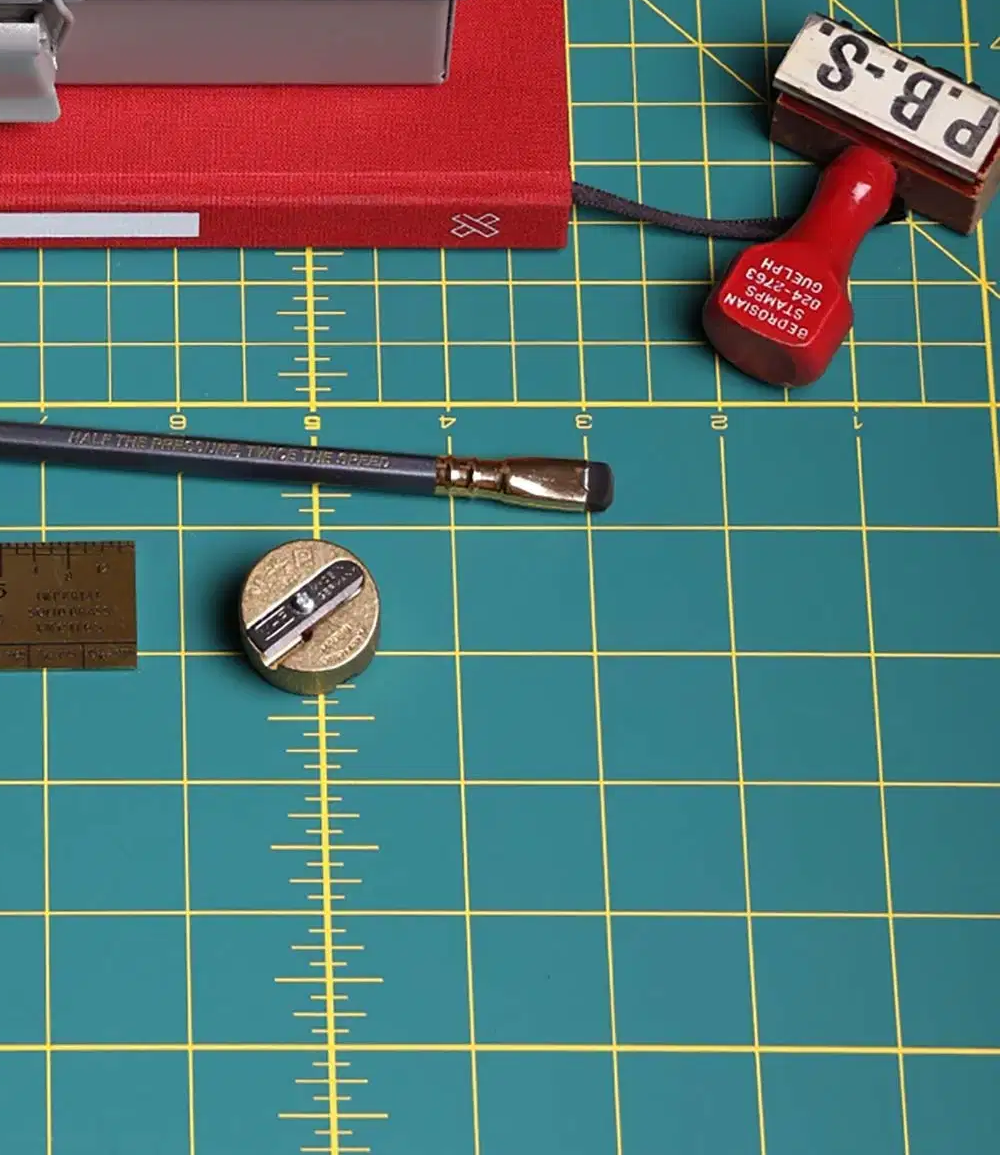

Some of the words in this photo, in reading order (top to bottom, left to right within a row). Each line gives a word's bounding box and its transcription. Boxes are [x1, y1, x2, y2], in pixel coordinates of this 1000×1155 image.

[760, 257, 823, 294] GUELPH
[744, 285, 805, 321] STAMPS
[723, 292, 809, 340] BEDROSIAN
[303, 414, 322, 431] 5
[438, 415, 456, 430] 4
[575, 413, 592, 430] 3
[711, 414, 728, 431] 2
